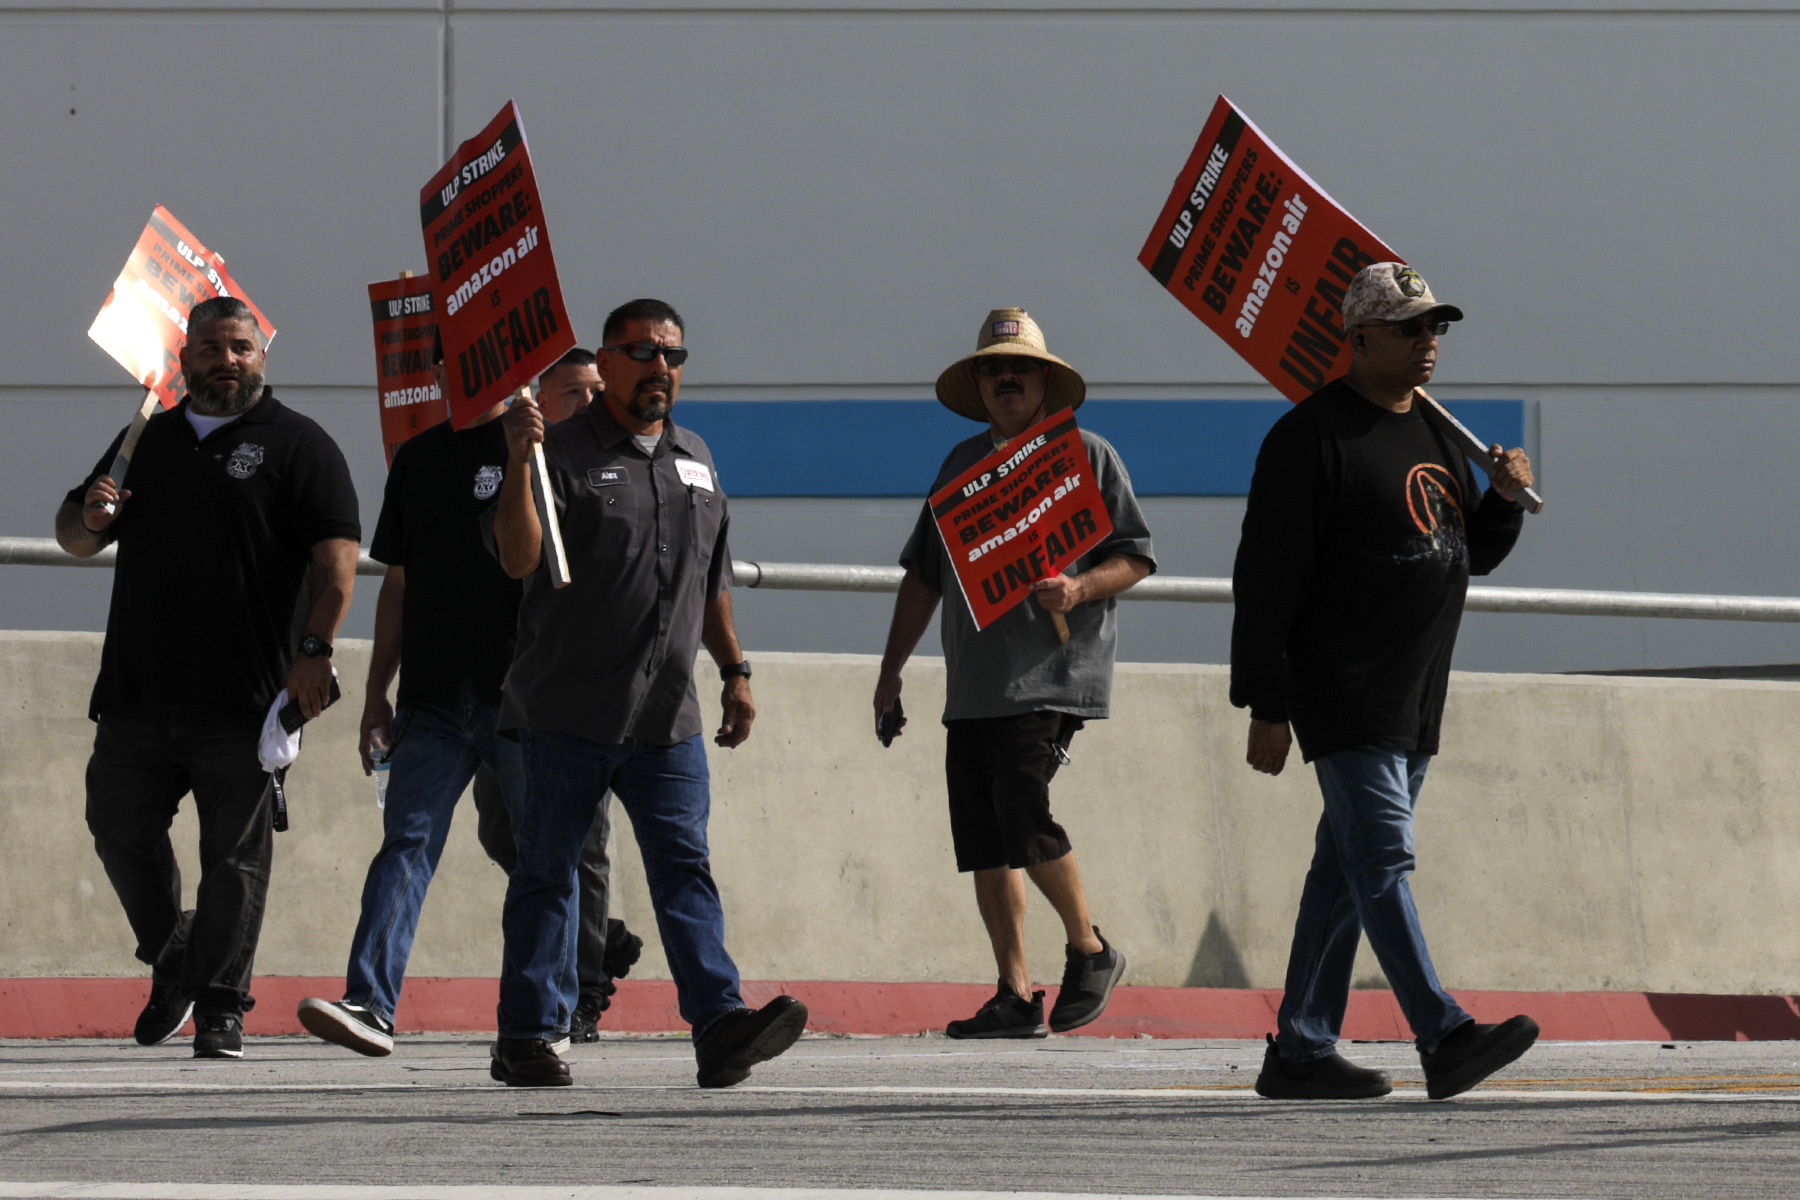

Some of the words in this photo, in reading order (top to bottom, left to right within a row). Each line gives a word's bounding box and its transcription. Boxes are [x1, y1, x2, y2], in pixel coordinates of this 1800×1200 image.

[434, 210, 464, 247] PRIME
[465, 161, 523, 218] SHOPPERS
[441, 176, 460, 206] ULP
[462, 139, 505, 185] STRIKE
[1169, 211, 1192, 249] ULP
[1190, 143, 1229, 210] STRIKE
[438, 190, 532, 283] BEWARE:
[1183, 234, 1217, 291] PRIME
[1210, 148, 1258, 238] SHOPPERS
[1202, 171, 1283, 315] BEWARE:
[153, 244, 195, 284] PRIME
[177, 241, 204, 268] ULP
[447, 247, 516, 316] amazon
[517, 226, 538, 258] air
[1235, 231, 1292, 338] amazon
[1282, 193, 1308, 234] air
[1284, 277, 1301, 295] IS
[135, 278, 189, 334] amaz
[388, 300, 402, 317] ULP
[404, 294, 430, 314] STRIKE
[491, 290, 501, 308] IS
[381, 330, 400, 345] PRIME
[459, 287, 558, 398] UNFAIR
[384, 386, 430, 409] amazon
[411, 414, 417, 427] IS
[601, 472, 618, 480] Alex
[953, 493, 999, 526] PRIME
[1001, 441, 1070, 496] SHOPPERS
[963, 473, 991, 498] ULP
[997, 434, 1047, 477] STRIKE
[958, 457, 1076, 545] BEWARE:
[968, 496, 1053, 562] amazon
[1054, 474, 1082, 501] air
[981, 508, 1097, 605] UNFAIR
[1028, 530, 1039, 543] IS
